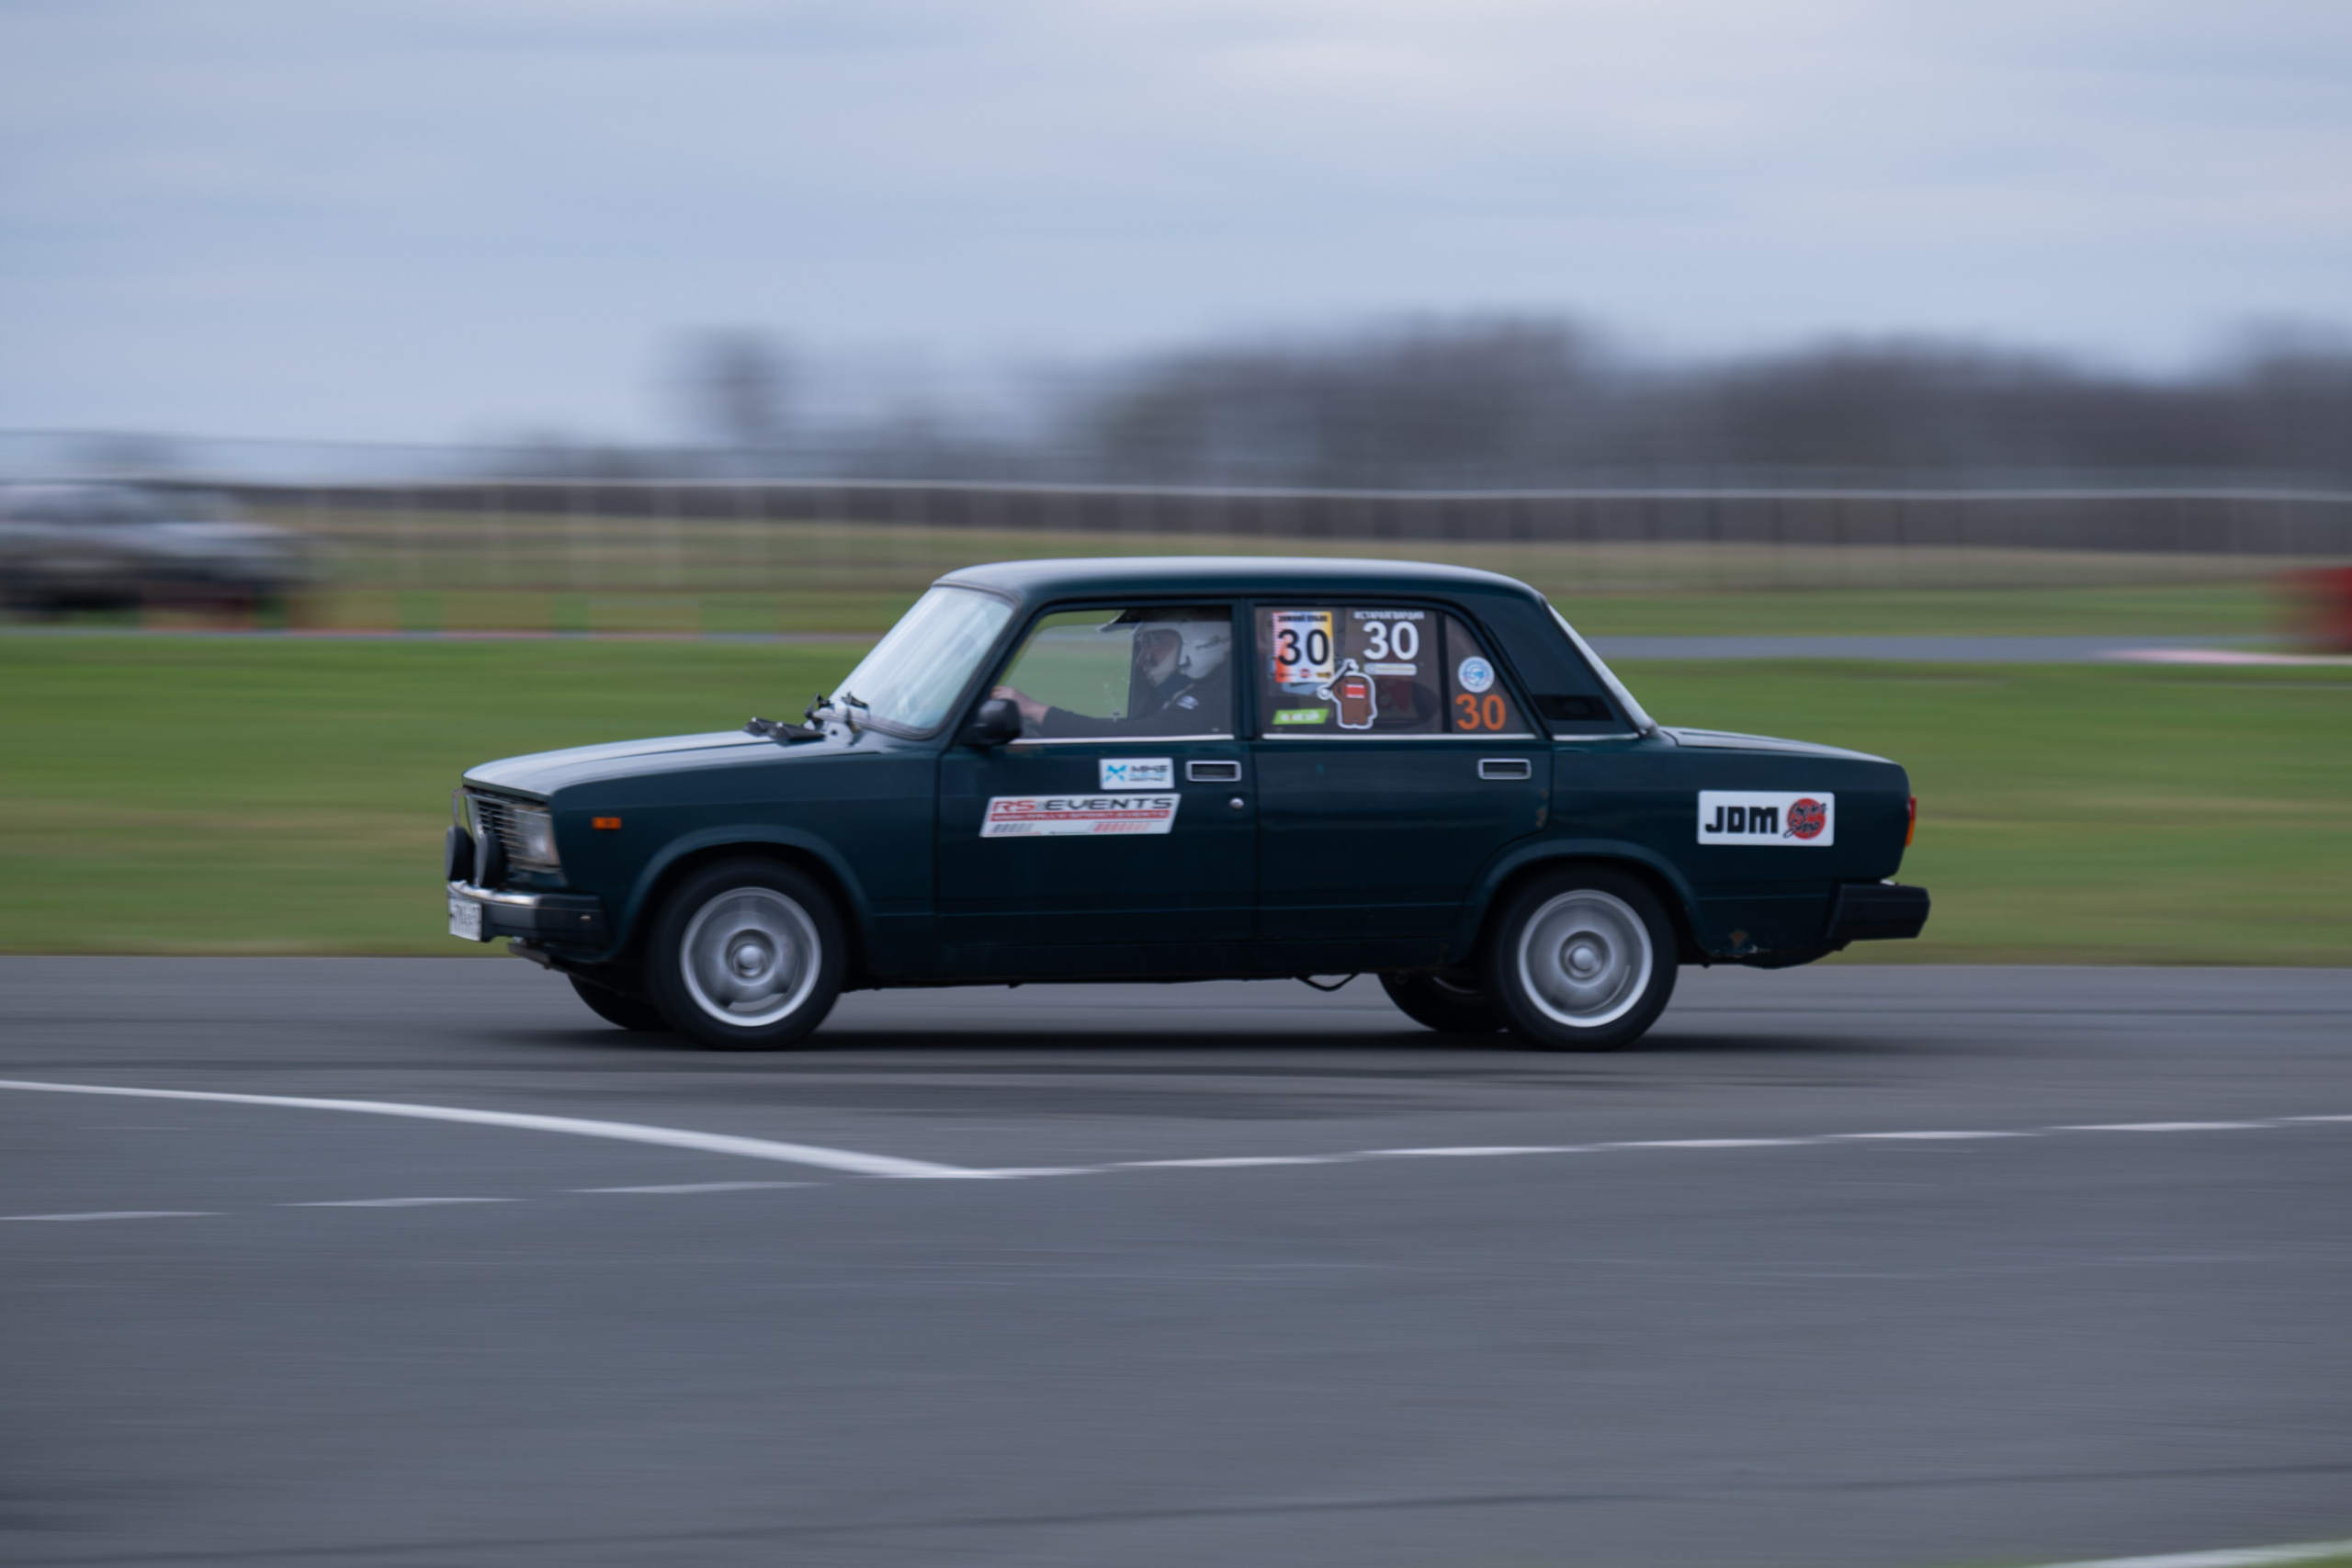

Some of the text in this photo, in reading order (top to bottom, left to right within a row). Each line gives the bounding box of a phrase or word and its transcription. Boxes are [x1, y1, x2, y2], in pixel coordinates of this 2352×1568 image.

[1278, 629, 1329, 665] 30
[1363, 621, 1419, 660] 30
[1455, 694, 1506, 731] 30
[992, 797, 1173, 813] RS EVENTS
[1705, 806, 1779, 834] JDM
